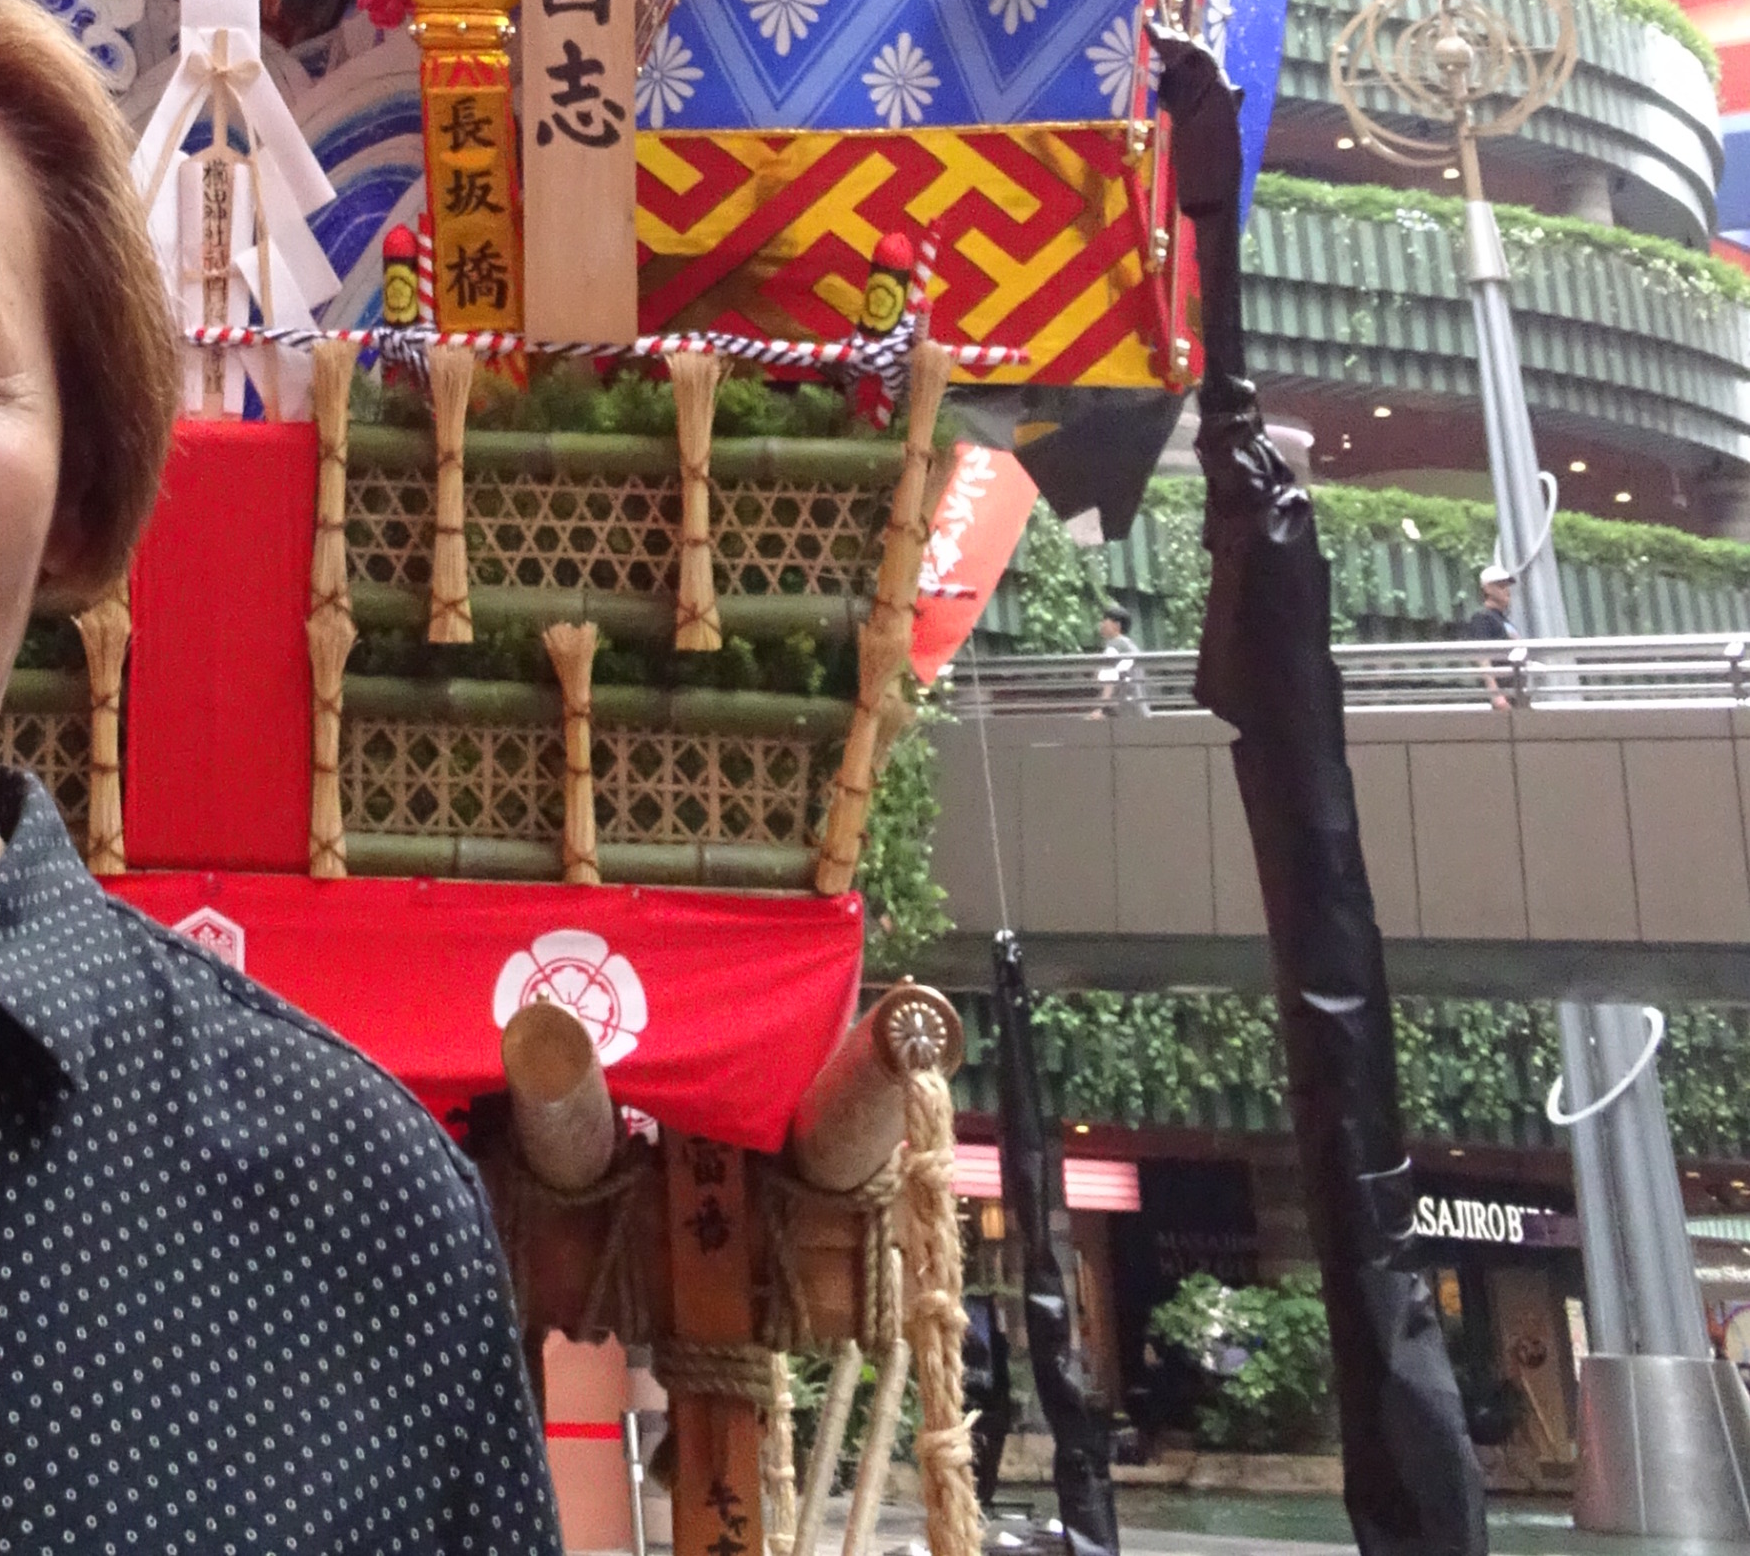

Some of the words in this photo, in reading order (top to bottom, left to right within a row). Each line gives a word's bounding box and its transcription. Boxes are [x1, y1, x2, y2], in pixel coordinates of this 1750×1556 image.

[440, 97, 510, 311] 長坂橋
[1414, 1195, 1506, 1242] SAJIRO
